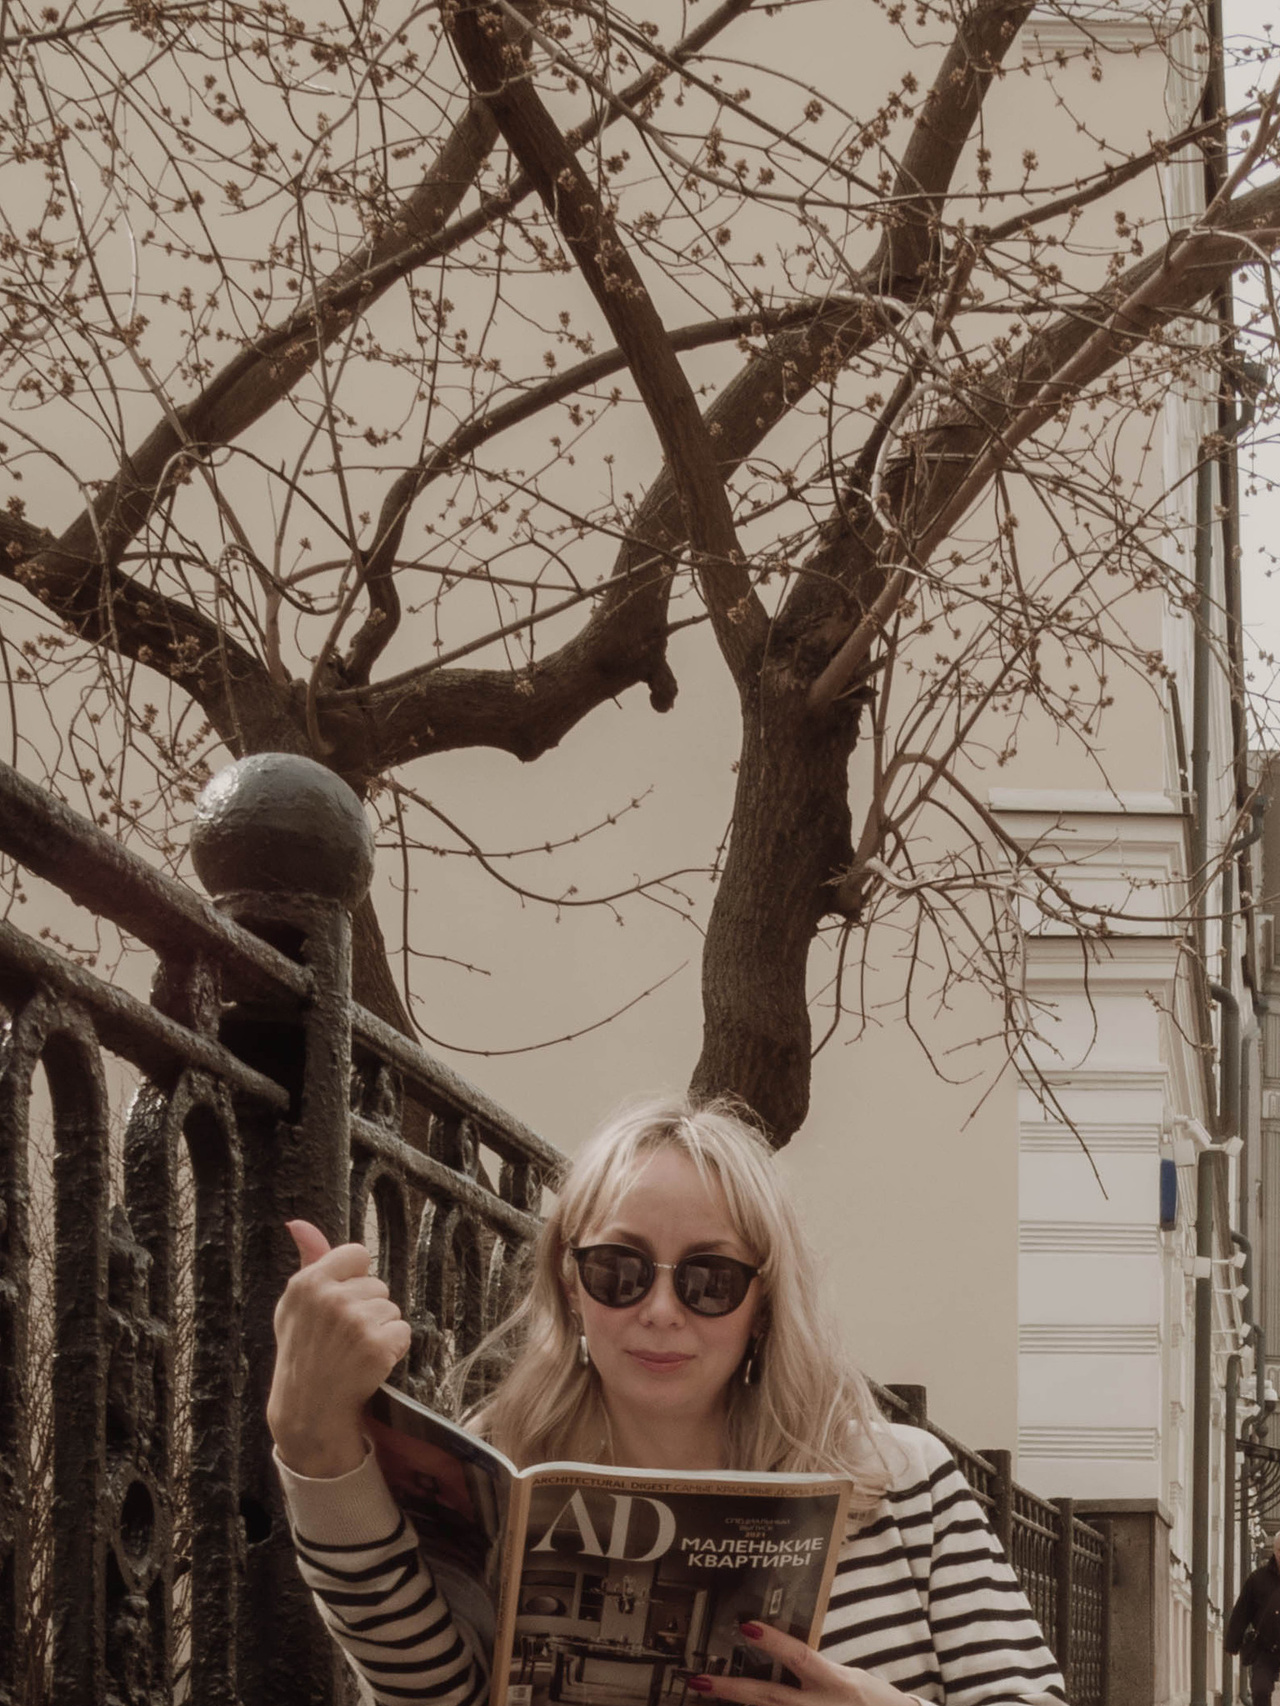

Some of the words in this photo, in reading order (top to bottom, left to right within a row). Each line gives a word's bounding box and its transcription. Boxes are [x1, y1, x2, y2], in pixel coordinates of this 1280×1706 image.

[533, 1476, 625, 1488] ARCHITECTURAL
[631, 1481, 671, 1491] DIGEST
[530, 1488, 677, 1562] AD
[681, 1537, 824, 1553] МАЛЕНЬКИЕ
[687, 1553, 812, 1569] КВАРТИРЫ
